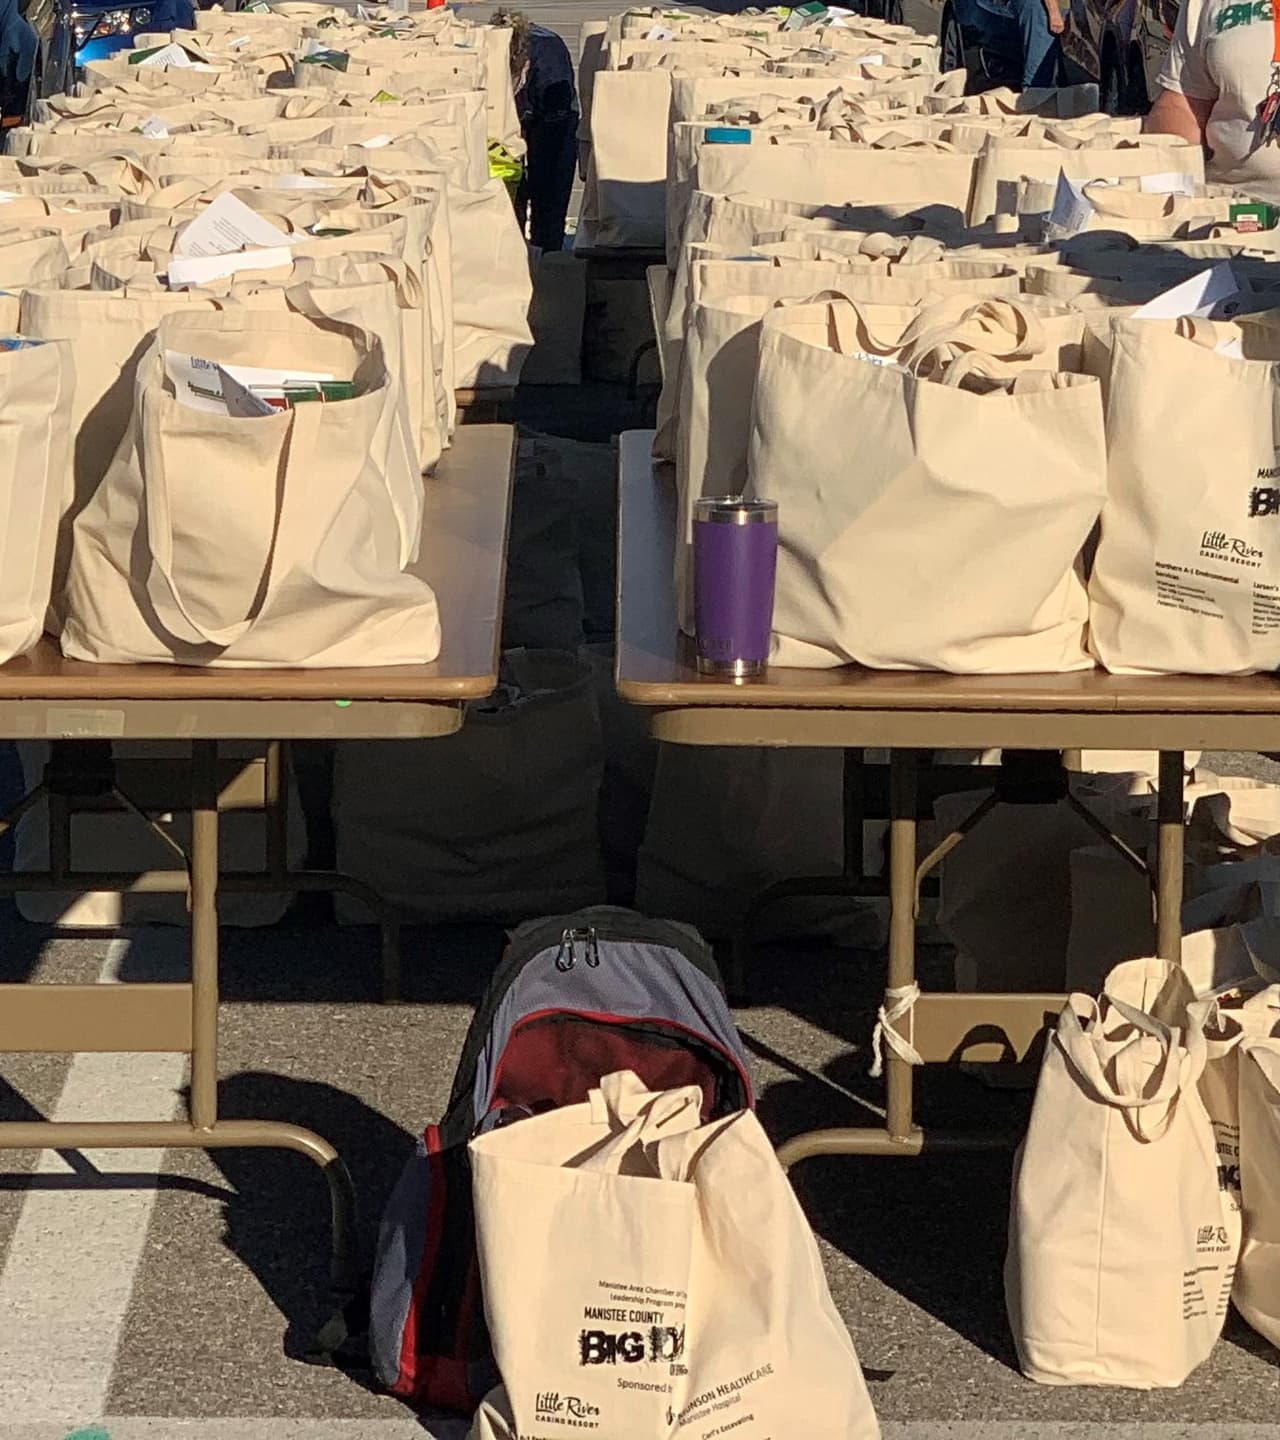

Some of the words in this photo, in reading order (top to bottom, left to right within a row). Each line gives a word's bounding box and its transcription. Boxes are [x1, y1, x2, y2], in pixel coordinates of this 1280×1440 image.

[1201, 531, 1229, 550] Little
[1228, 537, 1264, 559] River
[1199, 550, 1229, 562] CASINO
[1230, 555, 1262, 569] RESORT
[599, 1280, 627, 1290] Manistee
[628, 1284, 644, 1293] Area
[645, 1286, 675, 1296] Chamber
[610, 1292, 644, 1305] Leadership
[645, 1297, 674, 1307] Program
[584, 1306, 627, 1322] MANISTEE
[629, 1310, 665, 1324] COUNTY
[578, 1329, 645, 1366] BIG
[617, 1377, 667, 1393] Sponsored
[716, 1363, 775, 1398] HEALTHCARE
[535, 1392, 564, 1414] Little
[562, 1396, 600, 1418] River
[678, 1407, 712, 1427] Manistee
[712, 1392, 742, 1412] Hospital
[535, 1415, 566, 1425] CASINO
[567, 1419, 600, 1429] RESORT
[720, 1413, 755, 1433] Excavating
